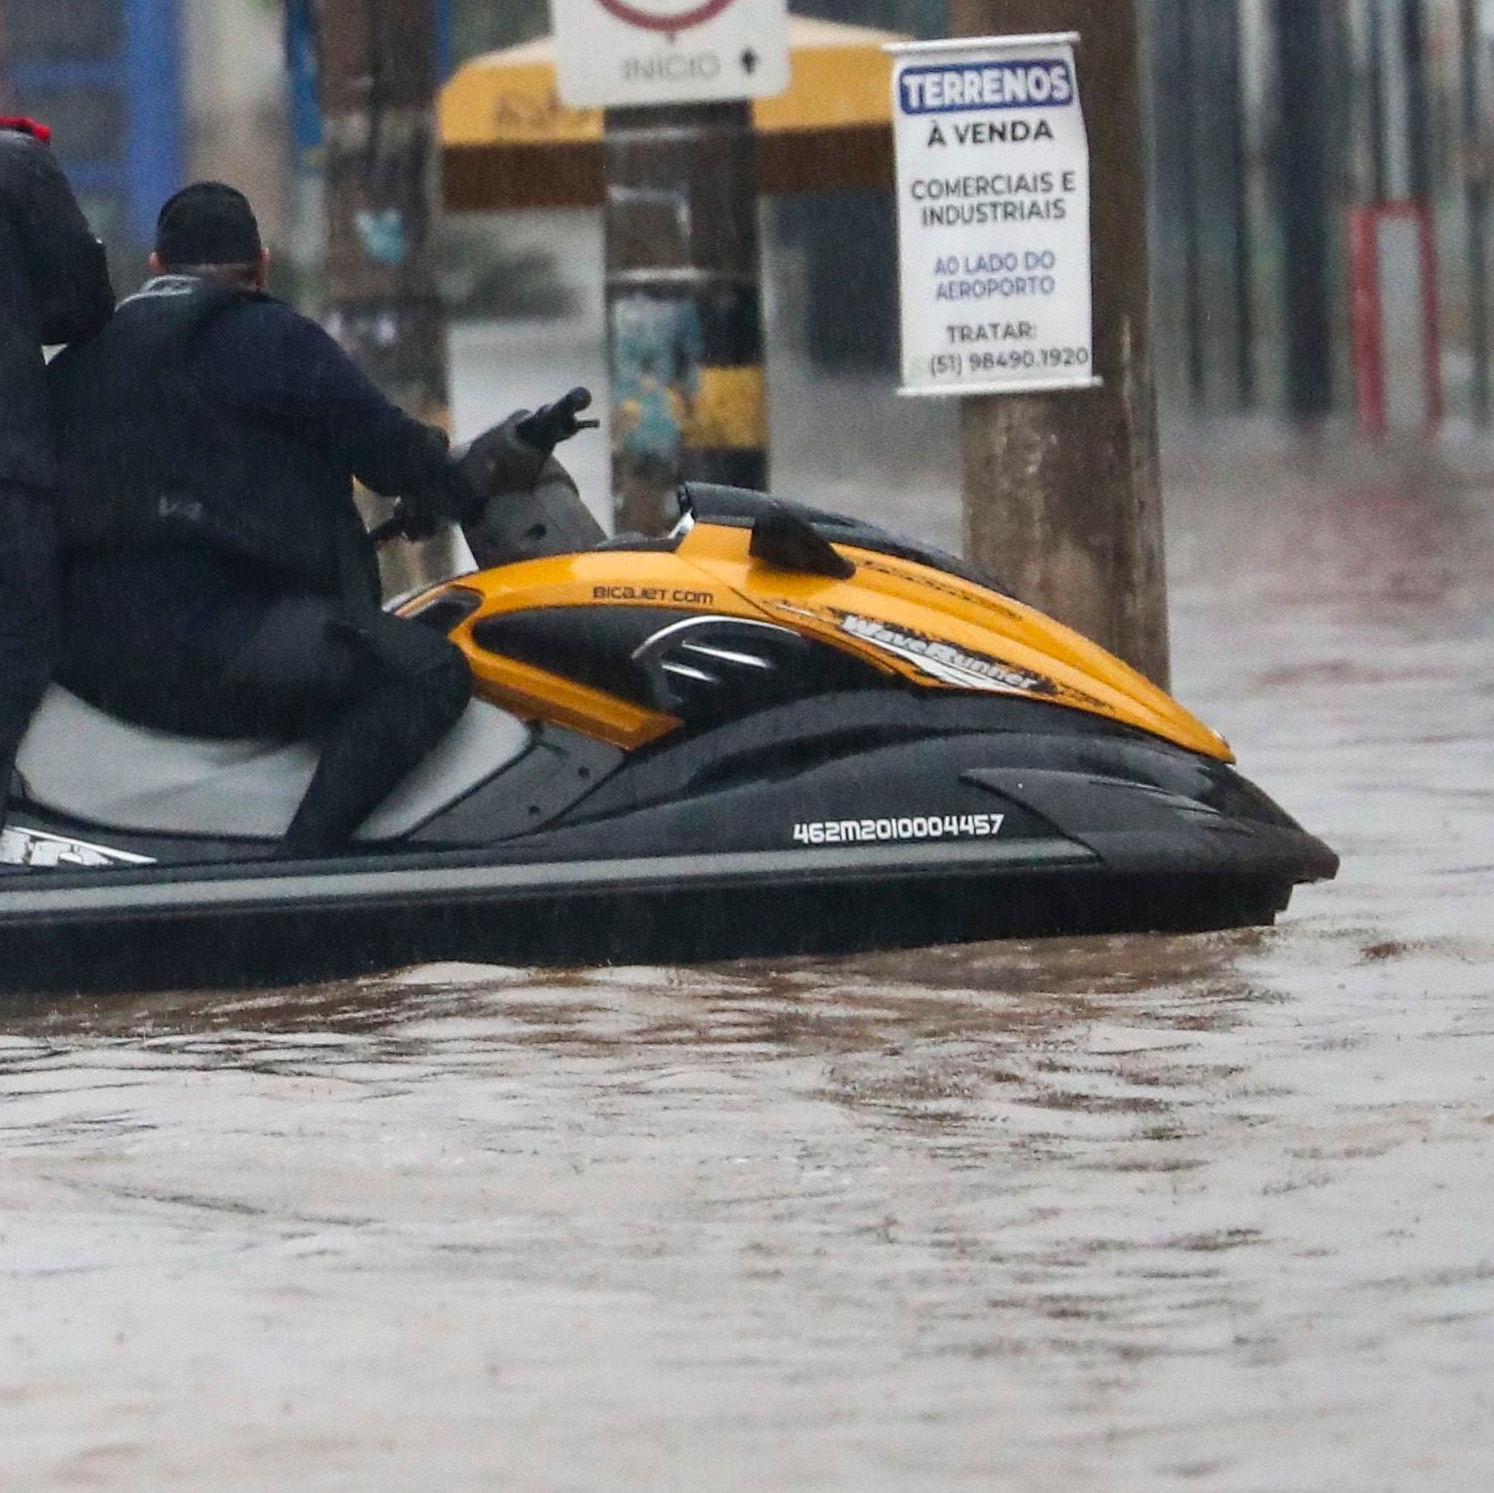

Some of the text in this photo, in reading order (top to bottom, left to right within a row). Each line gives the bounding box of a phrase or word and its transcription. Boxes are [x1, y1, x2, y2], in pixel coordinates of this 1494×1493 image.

[902, 66, 1070, 108] TERRENOS
[927, 118, 1055, 147] À VENDA
[911, 171, 1076, 201] COMERCIAIS E
[921, 198, 1067, 227] INDUSTRIAIS
[935, 249, 1055, 277] AO LADO DO
[936, 274, 1055, 301] AEROPORTO
[946, 321, 1037, 343] TRATAR:
[931, 353, 962, 376] (51)
[842, 613, 1039, 689] WaveRunner
